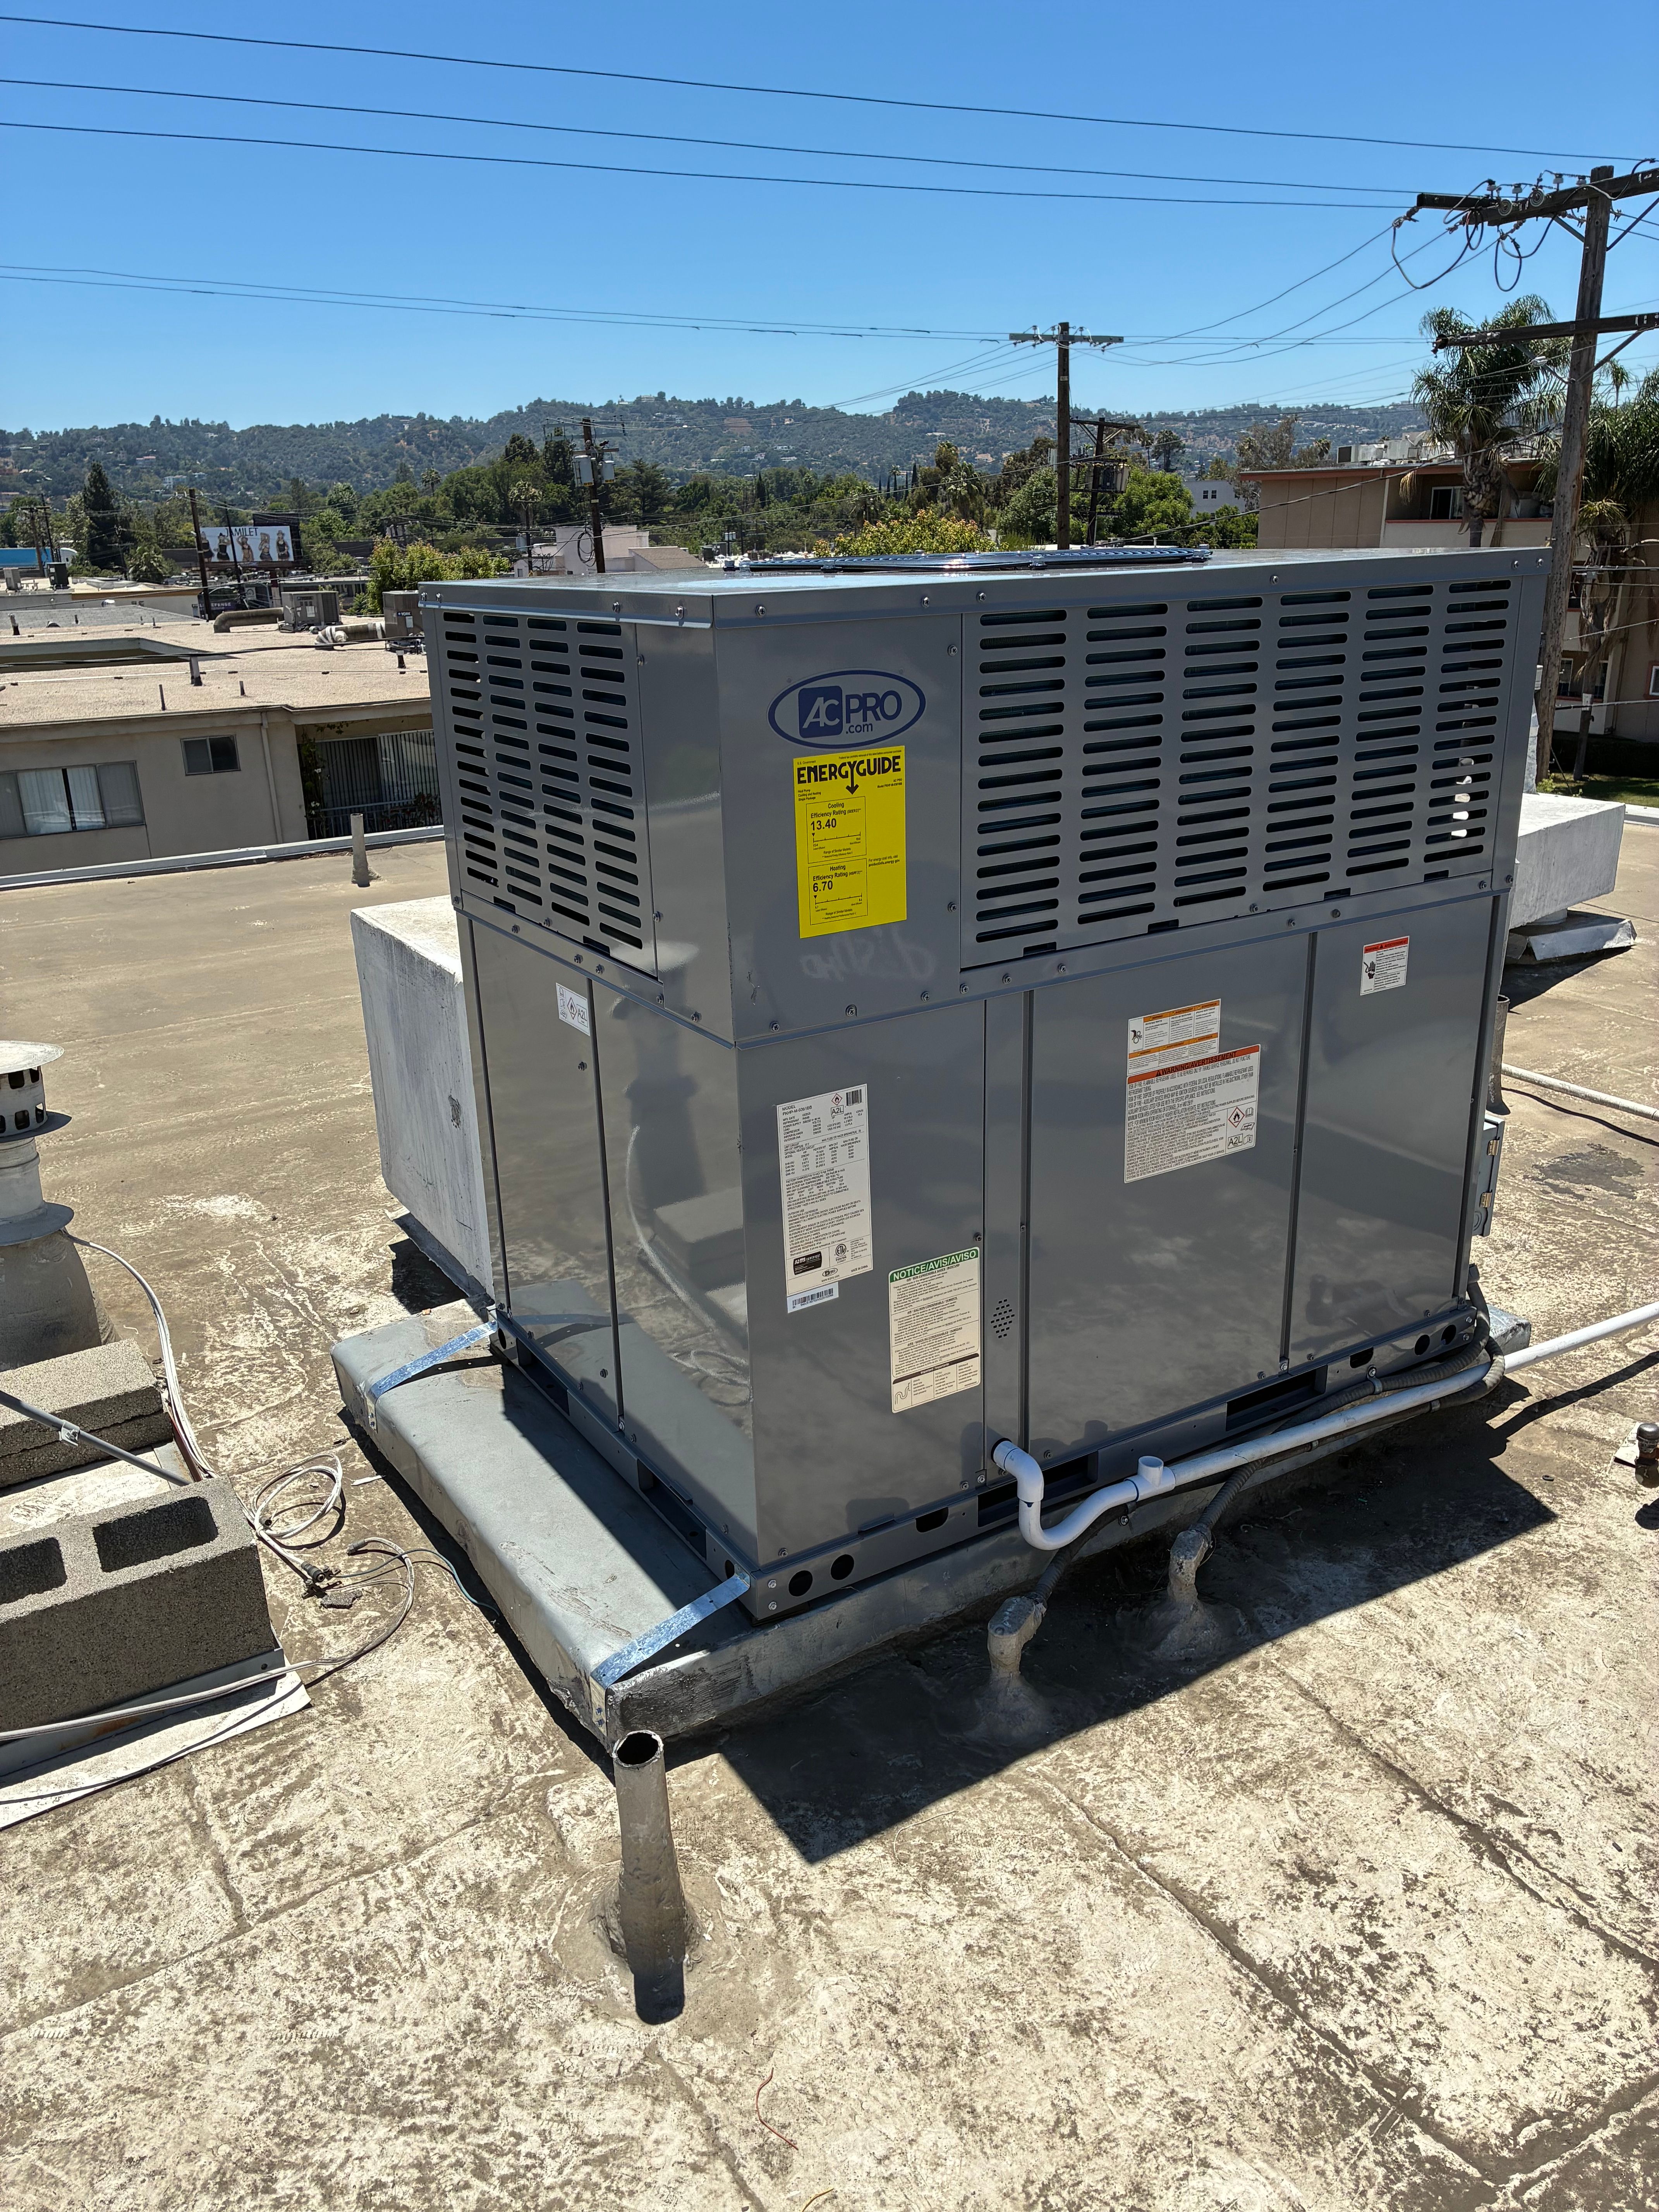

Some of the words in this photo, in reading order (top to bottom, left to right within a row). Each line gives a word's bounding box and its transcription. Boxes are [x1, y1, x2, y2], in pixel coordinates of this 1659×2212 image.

[845, 723, 873, 734] .com
[797, 755, 901, 785] ENERGYGUIDE
[827, 801, 845, 810] Cooling
[810, 810, 832, 820] Efficiency
[832, 808, 847, 817] Rating
[810, 817, 836, 831] 13.40
[830, 864, 846, 872] Heating
[812, 872, 834, 883] Efficiency
[834, 870, 848, 879] Rating
[812, 879, 833, 893] 6.70
[578, 1008, 587, 1021] A2L
[1161, 1051, 1237, 1076] WARNING/AVERTISSEMENT
[1228, 1137, 1243, 1146] A2L
[893, 1249, 976, 1281] NOTICE/AVIS/AVISO
